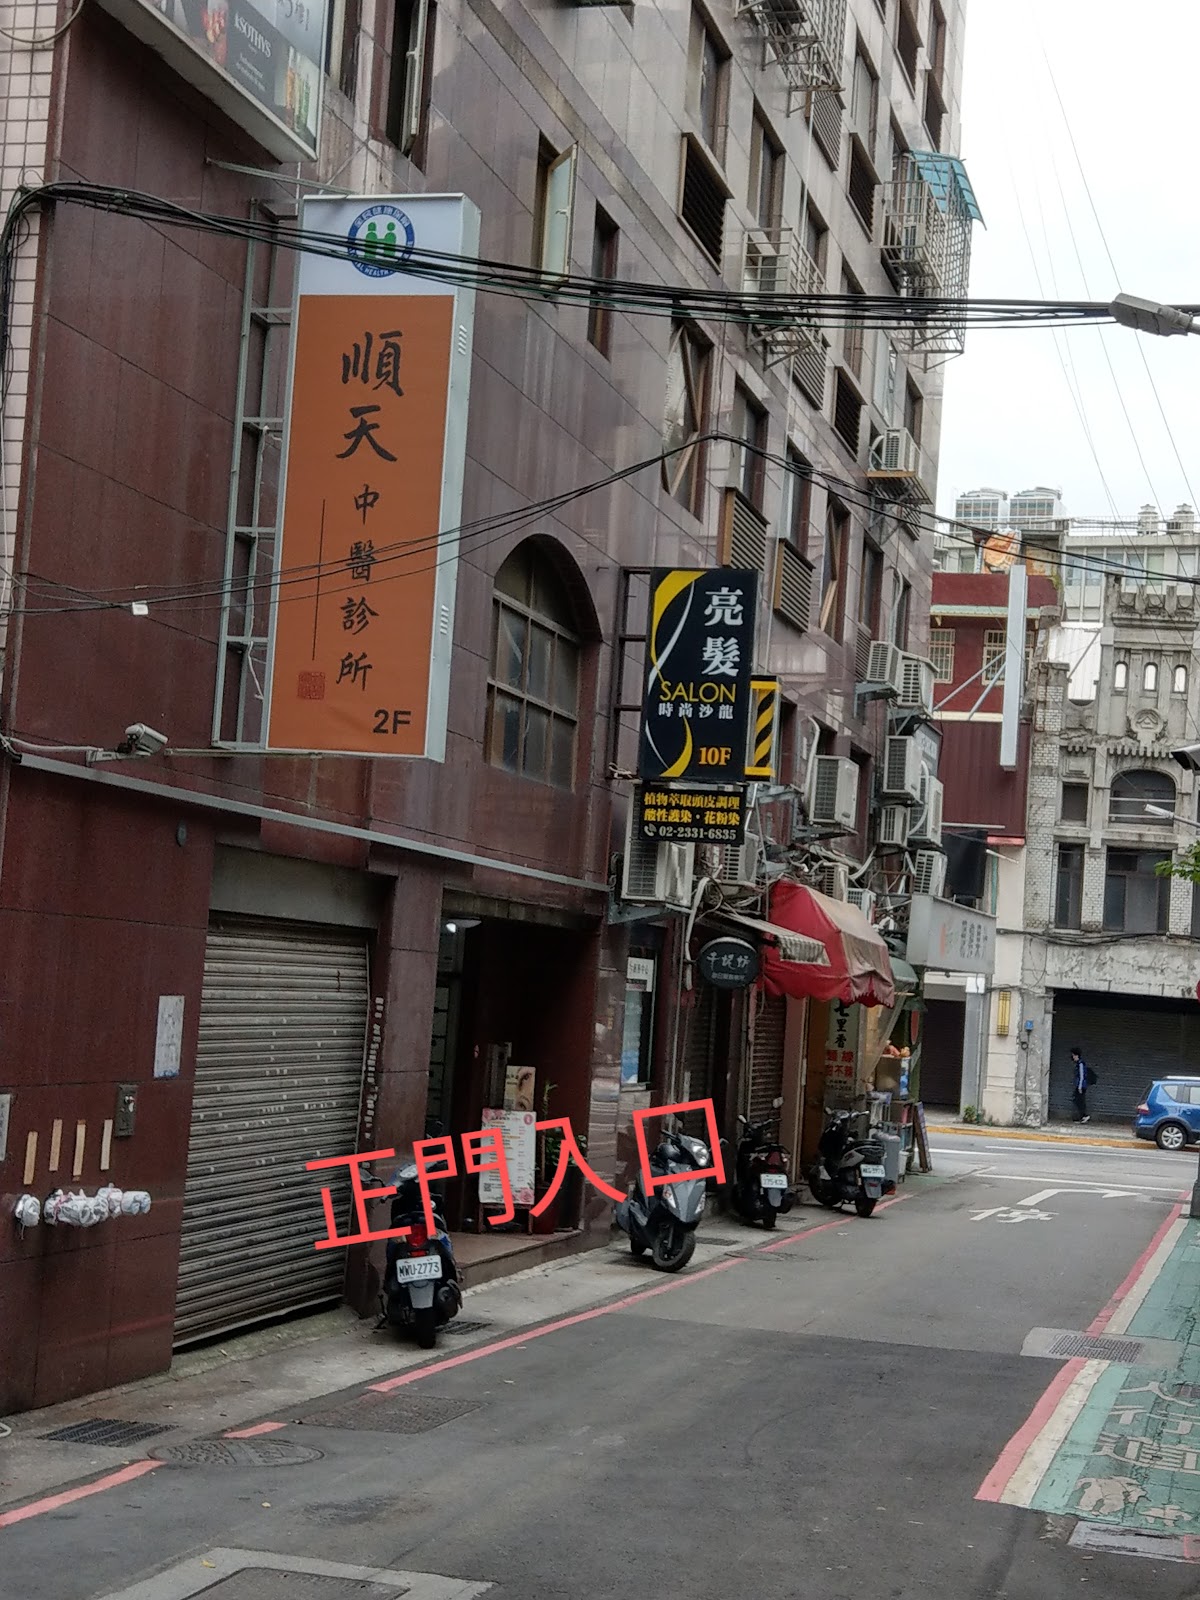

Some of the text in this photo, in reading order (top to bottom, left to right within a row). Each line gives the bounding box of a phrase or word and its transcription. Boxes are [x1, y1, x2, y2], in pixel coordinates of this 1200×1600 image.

[701, 587, 744, 677] 亮髮
[659, 681, 736, 703] SALON
[658, 702, 734, 720] 時尚沙龍
[373, 709, 412, 734] 2F
[699, 747, 732, 765] 10F
[658, 825, 737, 841] 02-2331-6835
